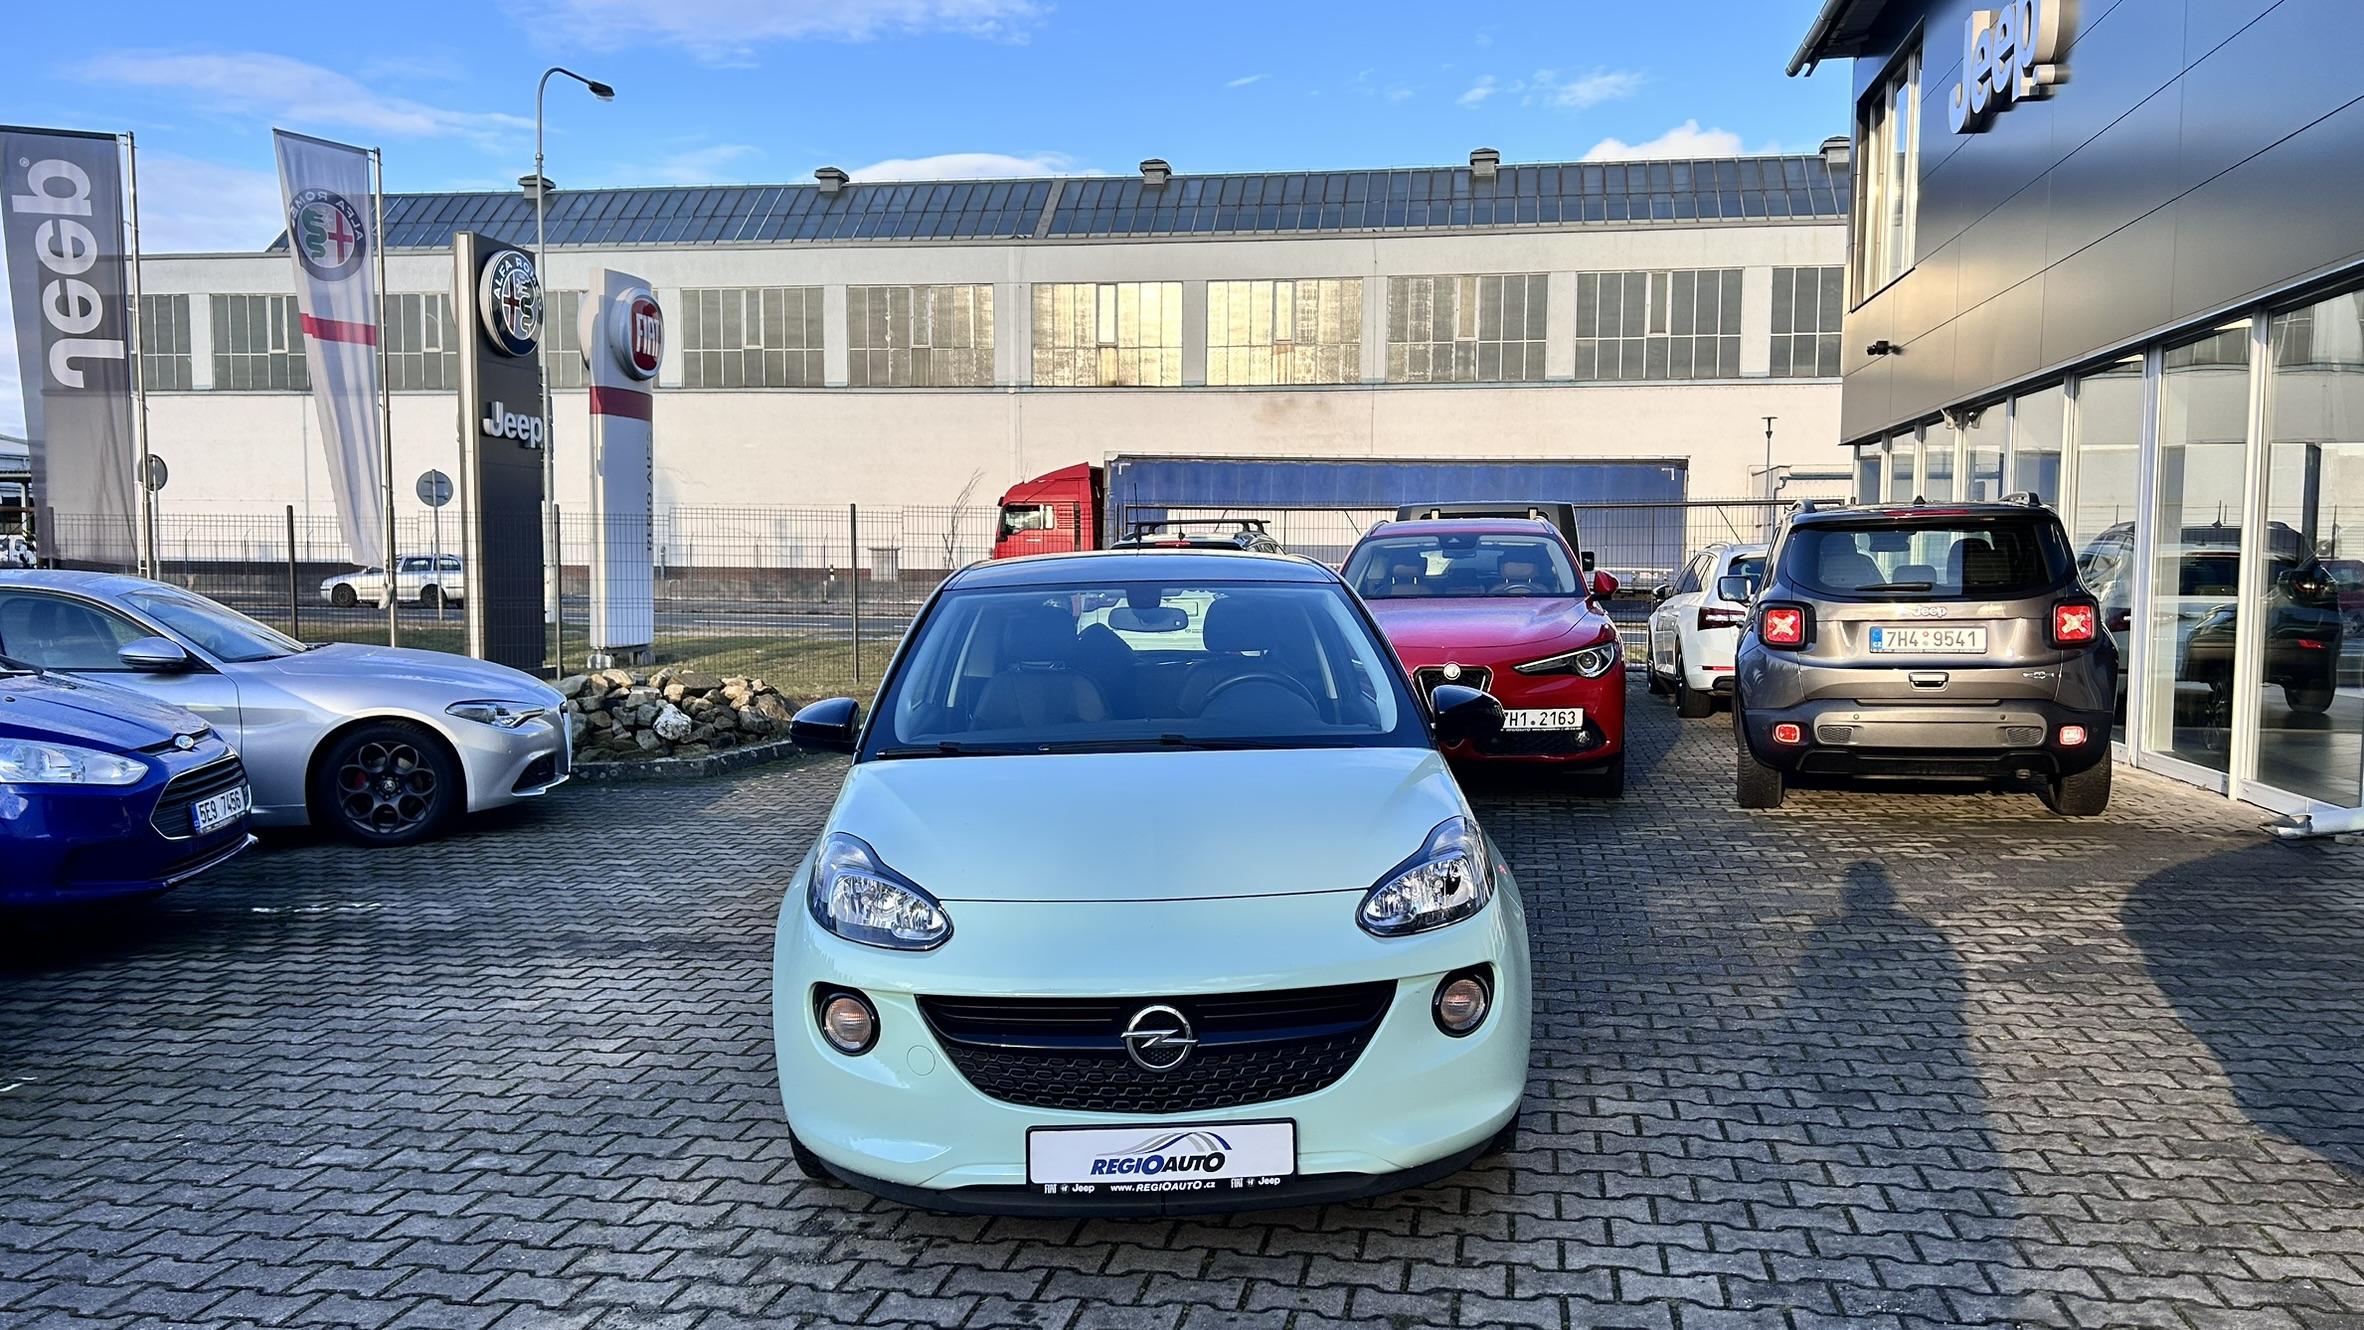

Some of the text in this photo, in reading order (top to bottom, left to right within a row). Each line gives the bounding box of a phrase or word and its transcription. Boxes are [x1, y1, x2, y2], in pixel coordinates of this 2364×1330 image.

[1949, 0, 2041, 134] Jeep
[493, 260, 513, 300] ALFA
[482, 401, 544, 449] Jeep
[1913, 605, 1948, 618] Jeep
[1887, 632, 1976, 647] 7H4 9541
[1539, 711, 1575, 726] 2163
[199, 791, 242, 823] 5E9 7456
[1090, 1152, 1226, 1175] REGIOAUTO
[1044, 1183, 1095, 1194] FIAT Jeep
[1230, 1176, 1281, 1189] FIAT Jeep
